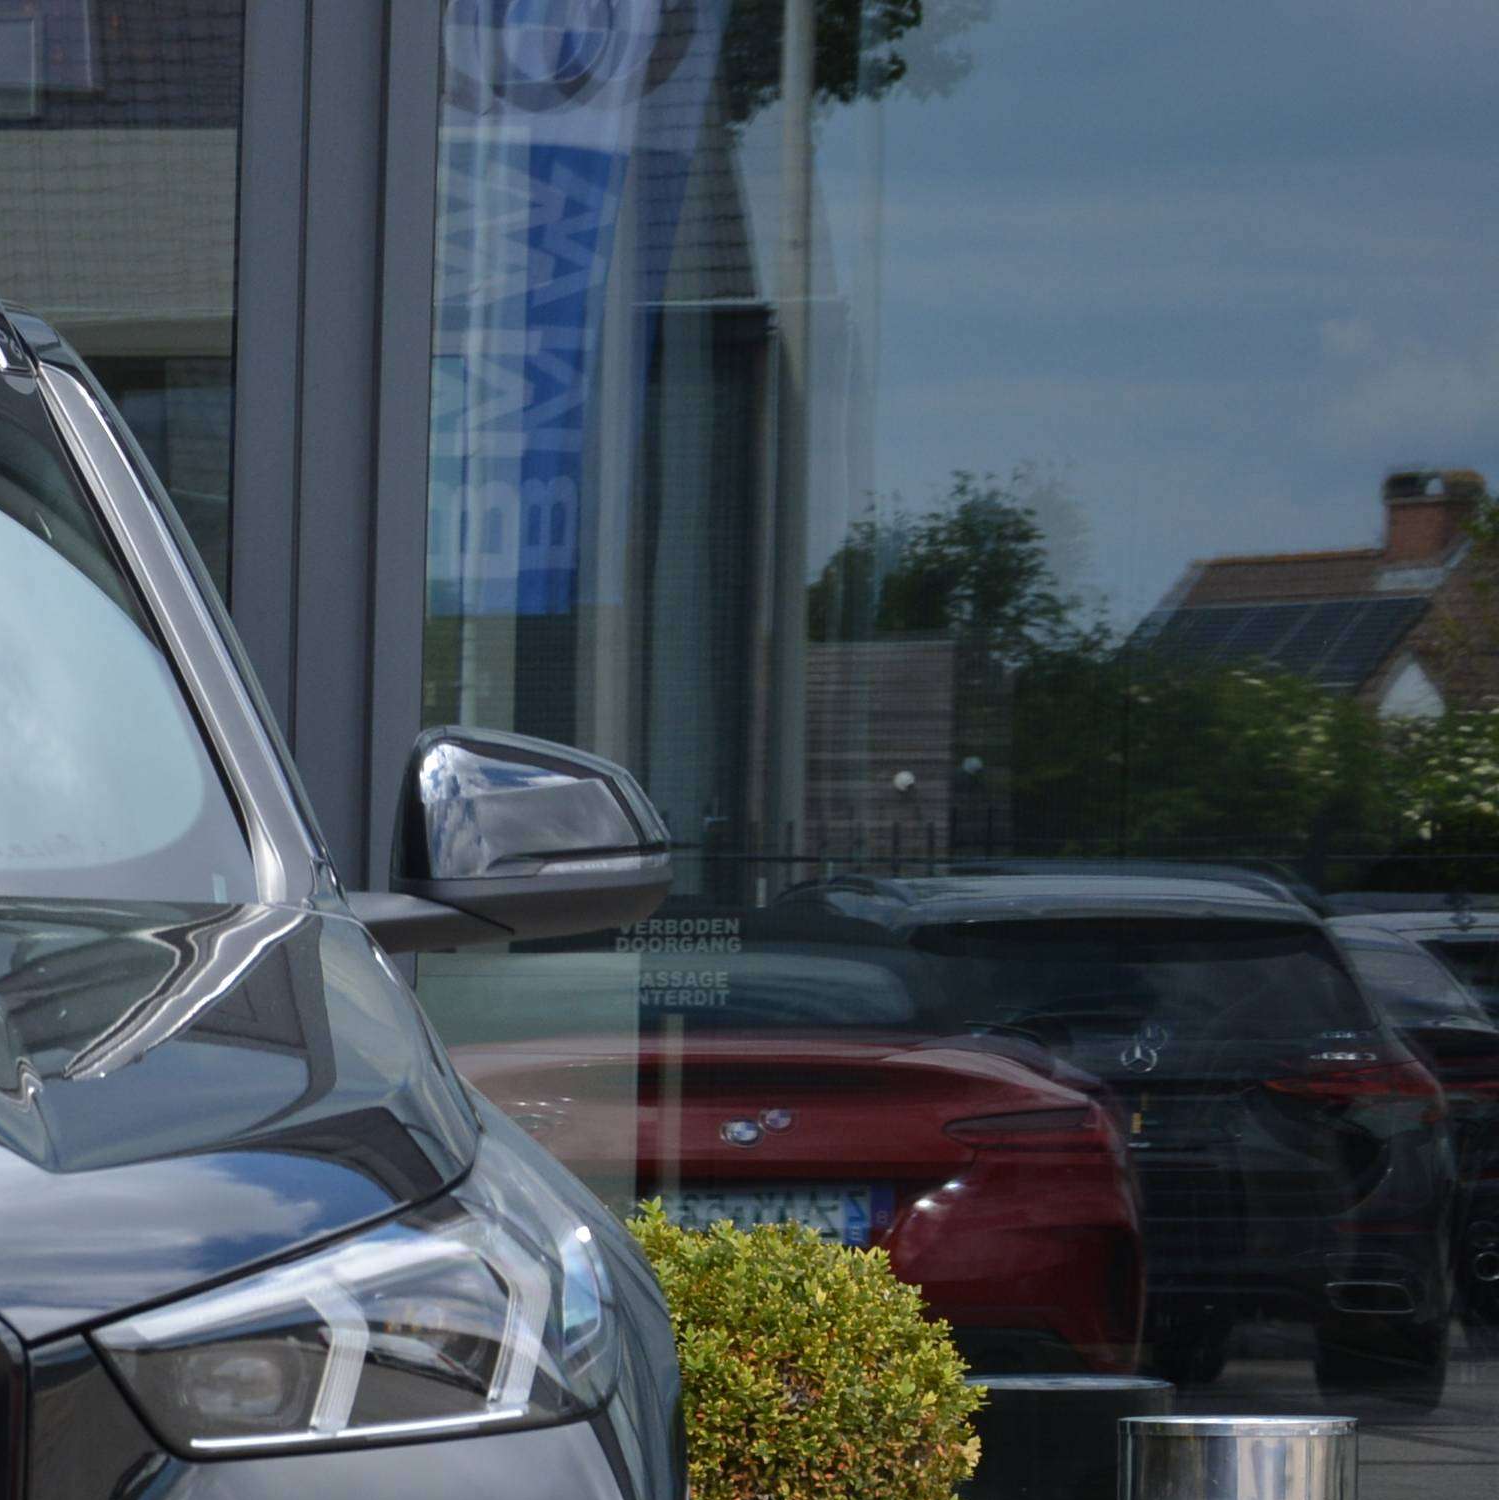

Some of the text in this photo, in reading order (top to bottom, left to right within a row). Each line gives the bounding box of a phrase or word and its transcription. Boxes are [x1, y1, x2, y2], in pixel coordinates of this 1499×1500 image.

[428, 160, 619, 578] BMW
[618, 917, 740, 935] VERBODEN
[615, 936, 742, 953] DOORGANG
[639, 970, 730, 988] ASSAGE
[636, 989, 731, 1006] NTERDIT
